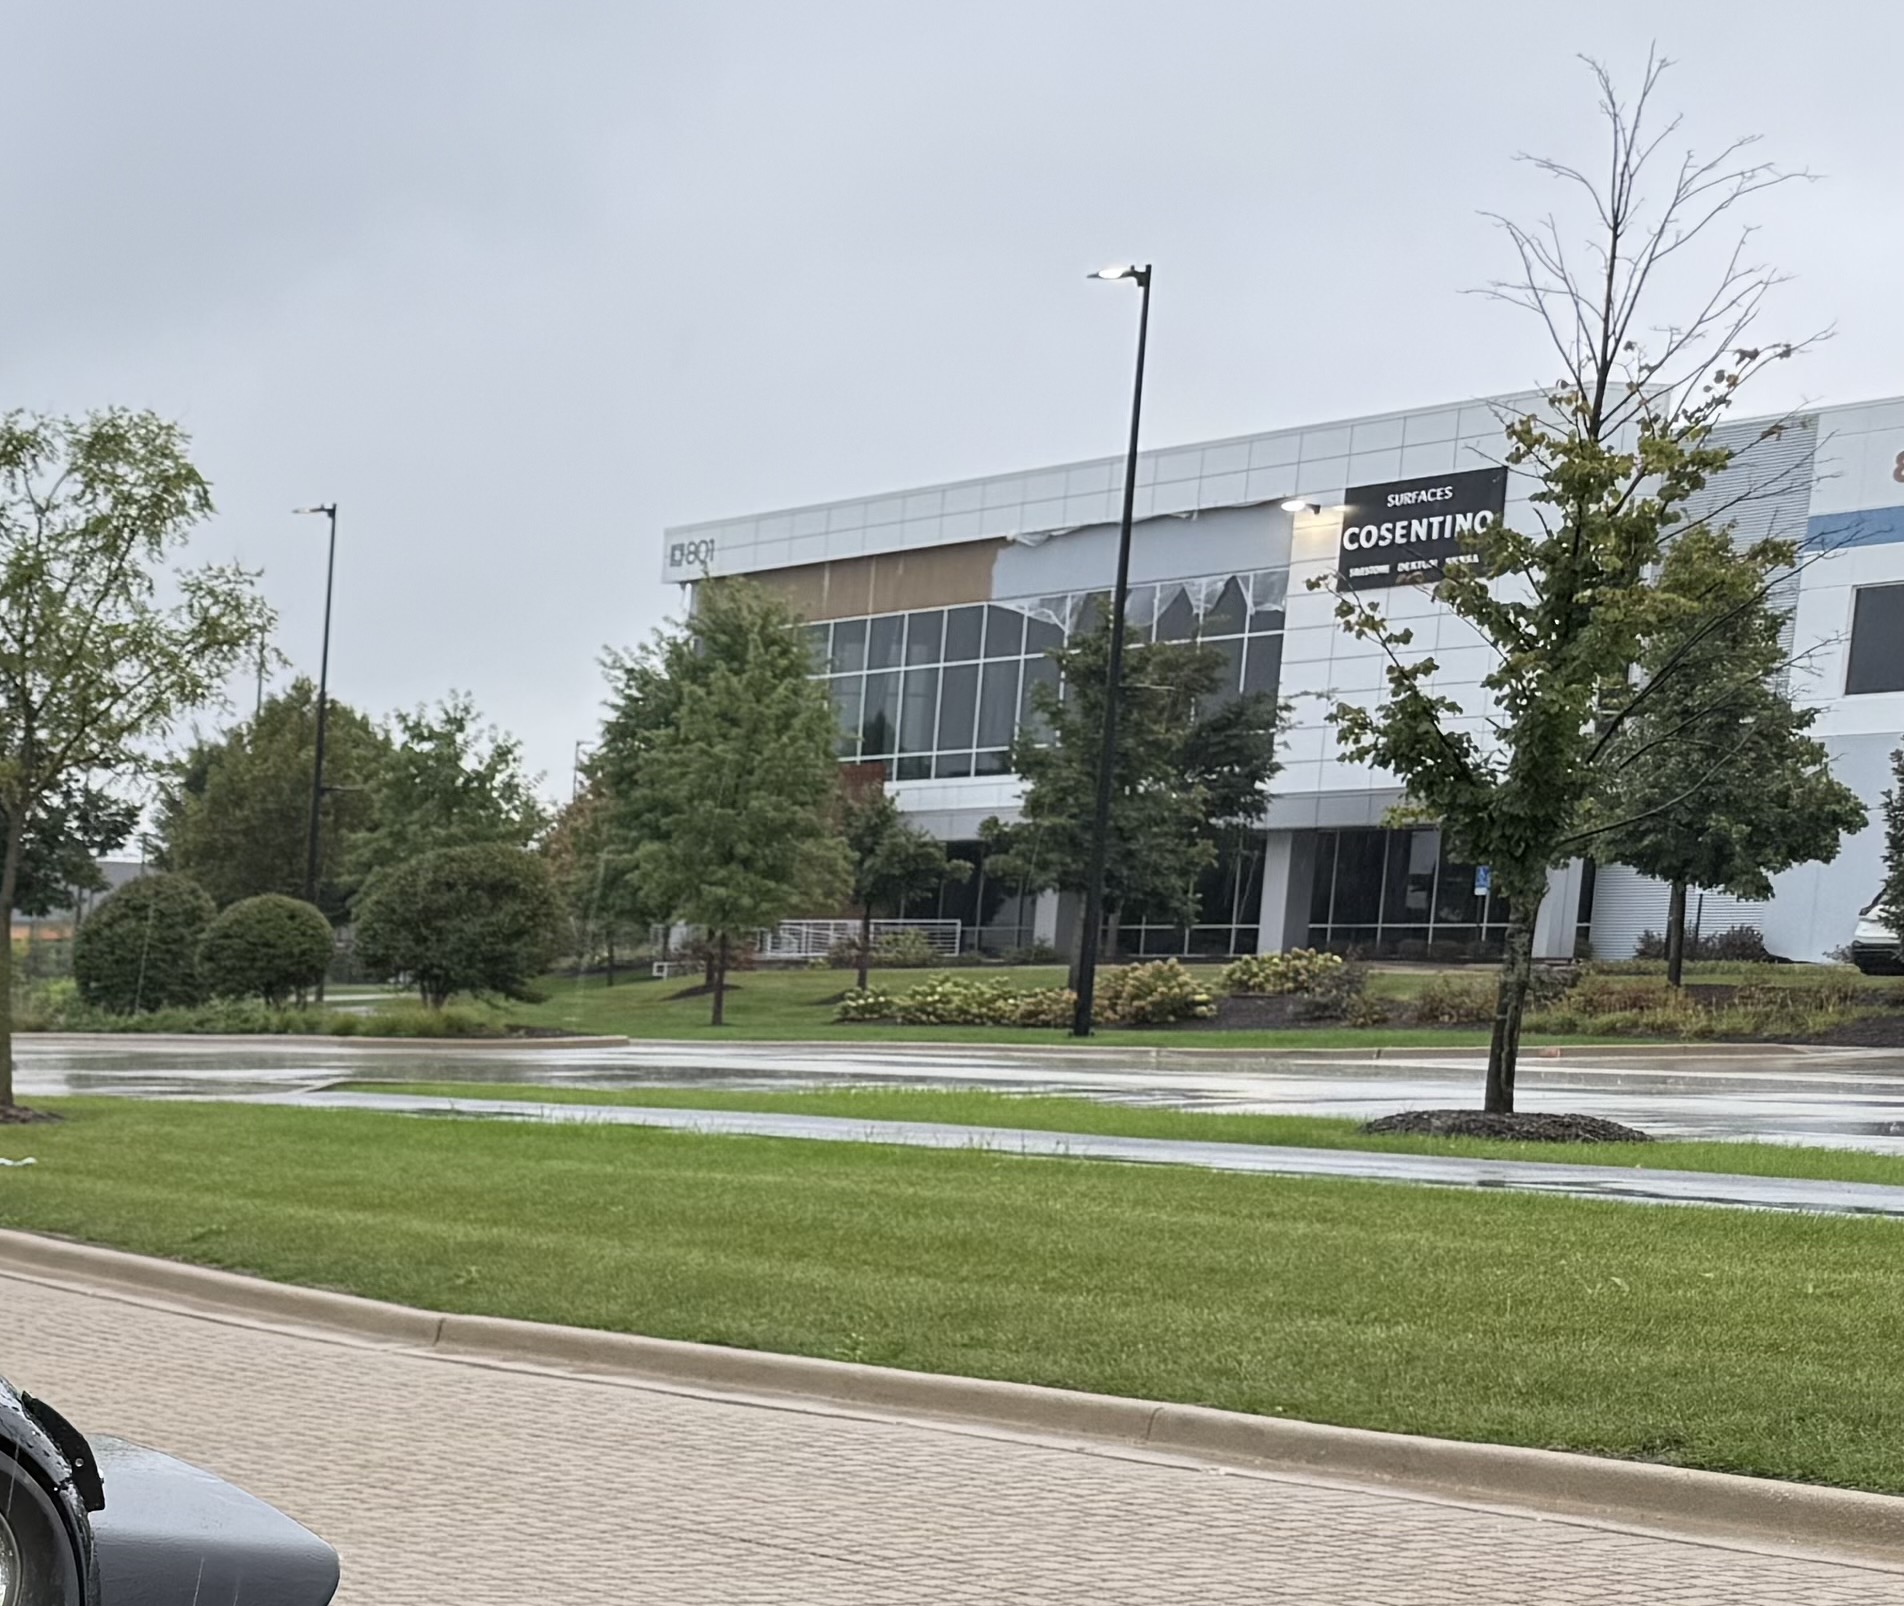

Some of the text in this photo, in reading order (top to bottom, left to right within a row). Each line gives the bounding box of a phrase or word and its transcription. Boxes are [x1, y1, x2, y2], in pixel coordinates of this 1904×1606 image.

[1386, 486, 1454, 508] SURFACES
[1343, 509, 1494, 551] COSENTINO
[685, 538, 715, 565] 801
